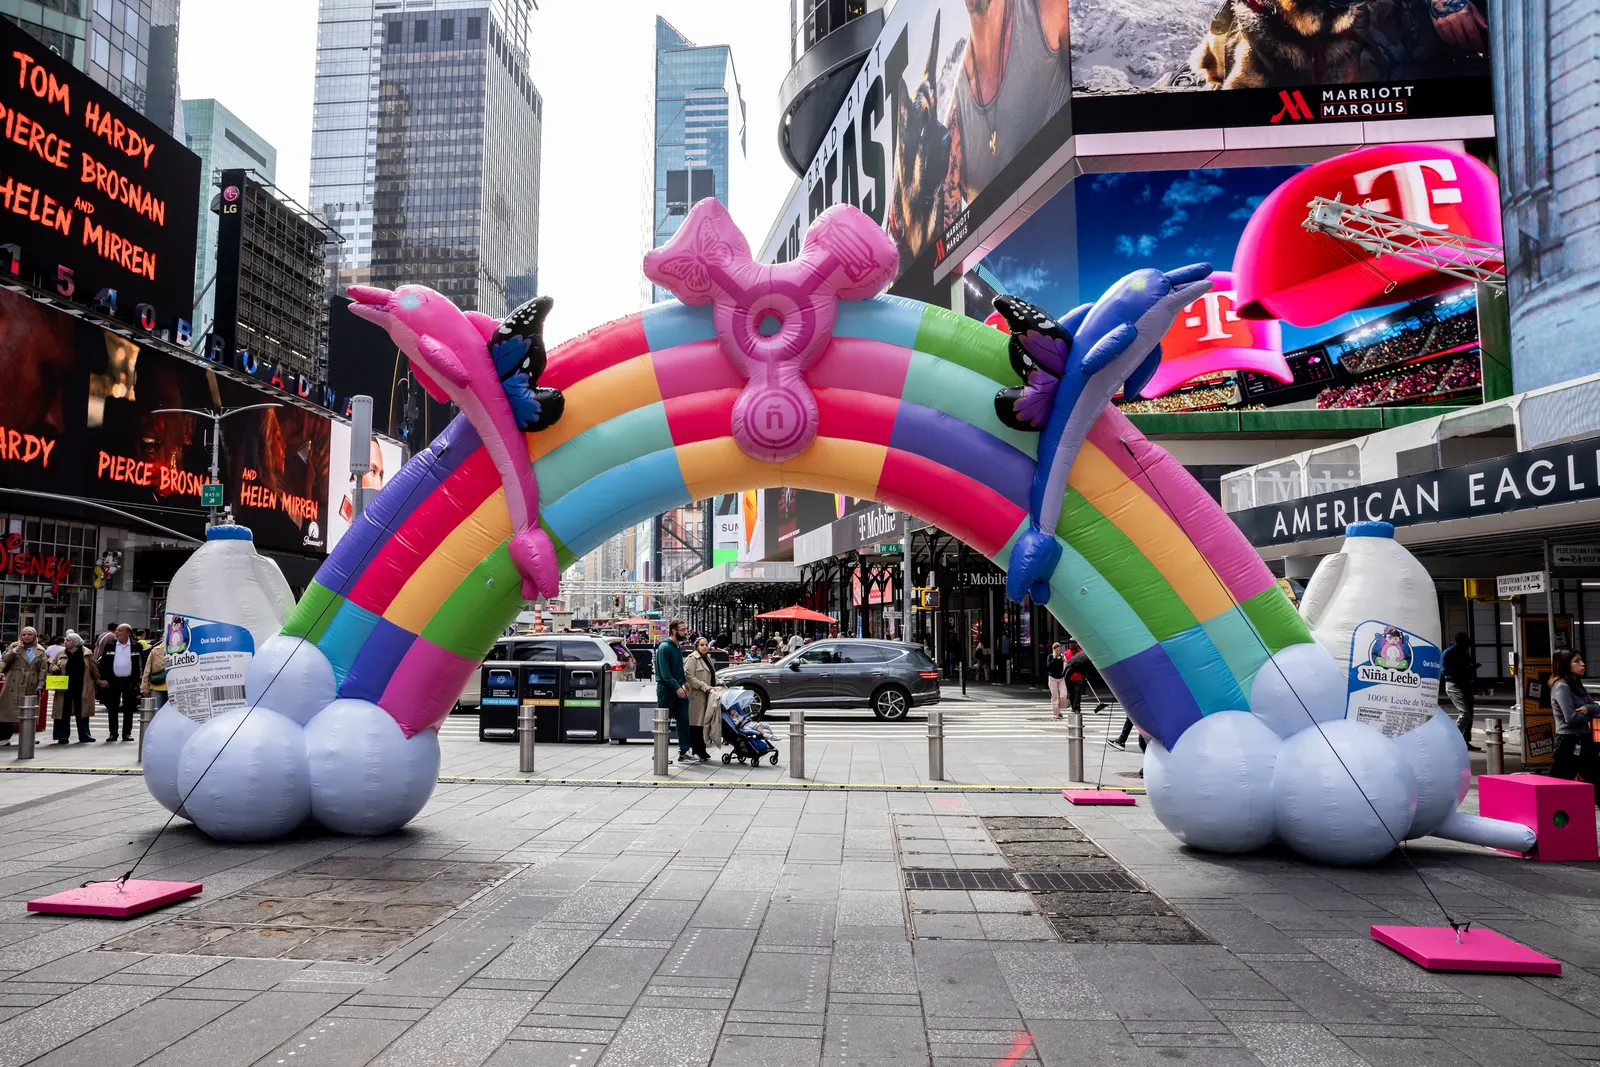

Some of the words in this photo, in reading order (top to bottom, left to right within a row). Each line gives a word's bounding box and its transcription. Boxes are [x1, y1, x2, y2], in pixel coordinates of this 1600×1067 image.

[1322, 86, 1414, 101] MARRIOTT
[13, 51, 70, 116] TOM
[85, 101, 155, 168] HARDY
[1323, 102, 1404, 116] MARQUIS
[81, 152, 165, 226] BROSNAN
[74, 196, 95, 214] AND
[223, 204, 237, 214] LG
[945, 209, 971, 241] MARRIOTT
[946, 224, 968, 252] MARQUIS
[83, 217, 156, 281] MIRREN
[765, 404, 784, 430] ñ
[98, 450, 154, 486] PIERCE
[242, 467, 257, 480] AND
[240, 481, 278, 510] HELEN
[281, 492, 318, 521] MIRREN
[1272, 480, 1440, 538] AMERICAN
[1468, 449, 1600, 507] EAGL
[867, 507, 896, 539] Mobile
[970, 572, 1007, 585] Mobile
[1499, 576, 1520, 585] PEDESTRIAN
[1530, 574, 1541, 582] ZONE
[174, 653, 196, 666] Leche
[200, 671, 243, 682] Vacacornio
[1361, 668, 1388, 682] Niña
[1390, 672, 1419, 685] Leche
[1367, 693, 1388, 703] 100%
[1390, 696, 1412, 706] Leche
[1530, 741, 1537, 750] IN
[1537, 738, 1553, 748] TIMES
[1532, 745, 1553, 757] SQUARE
